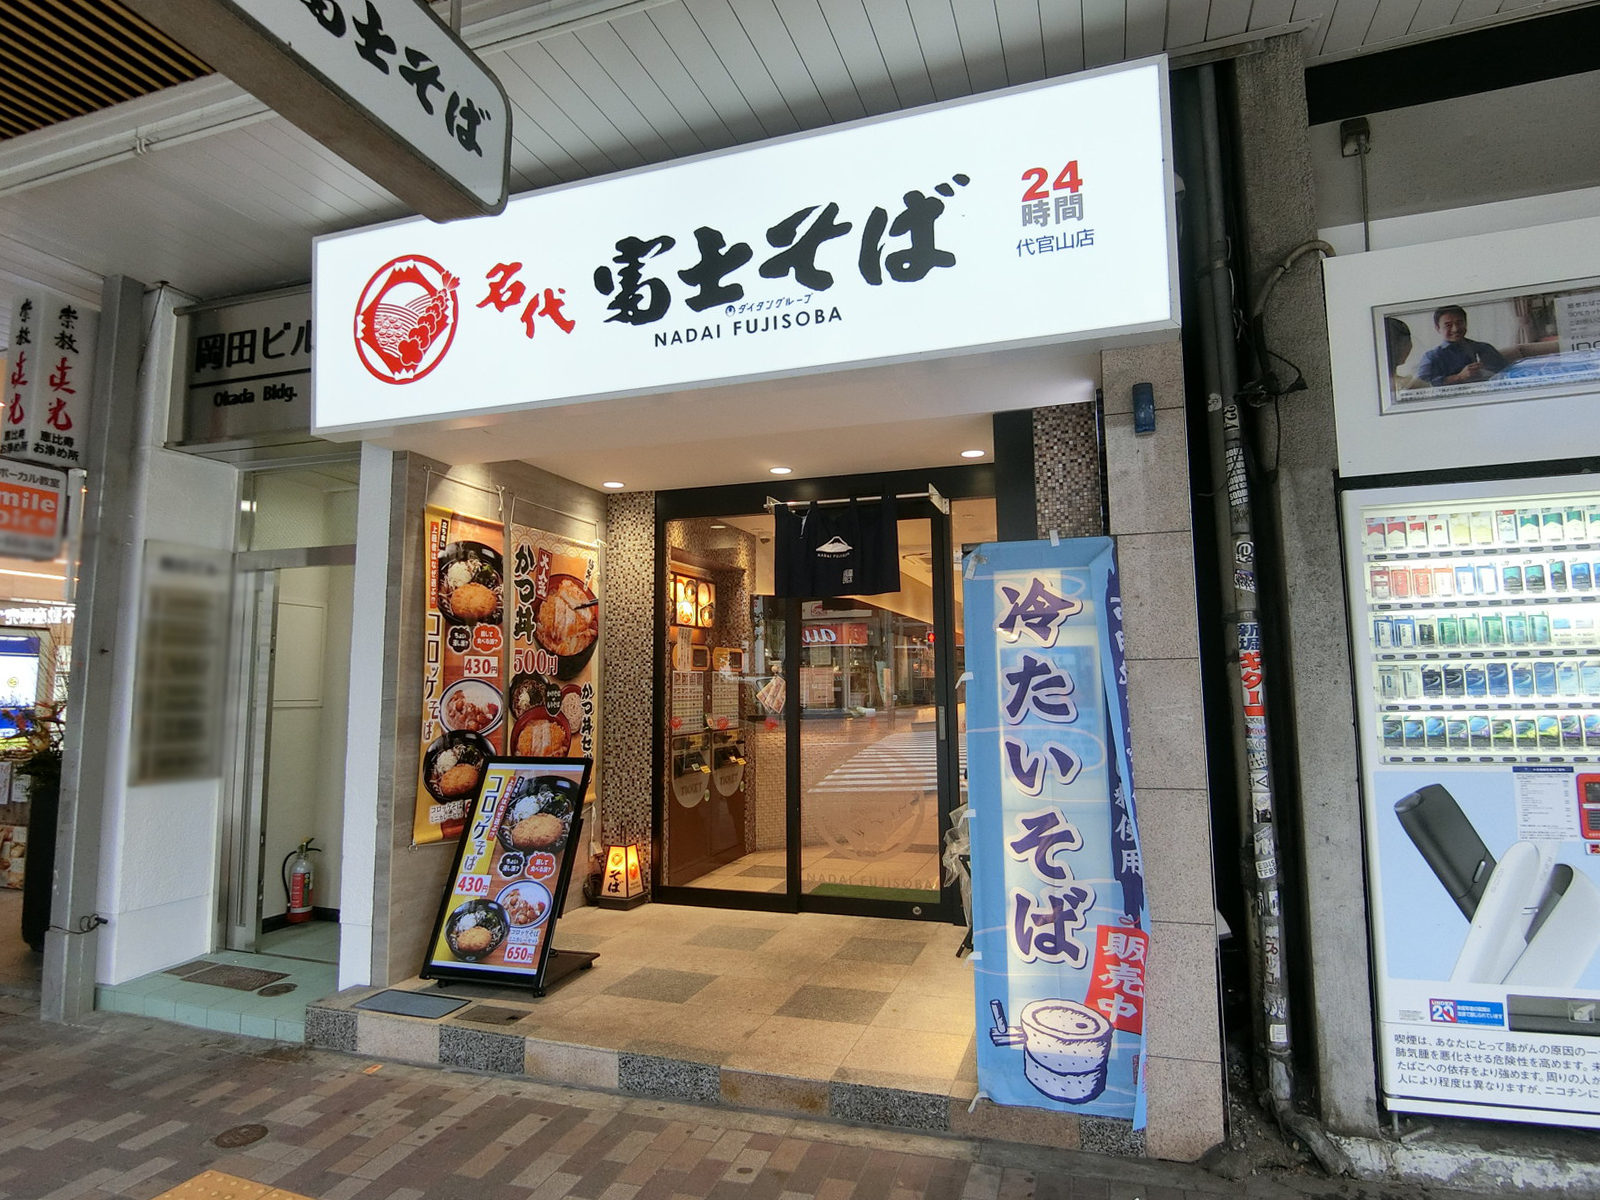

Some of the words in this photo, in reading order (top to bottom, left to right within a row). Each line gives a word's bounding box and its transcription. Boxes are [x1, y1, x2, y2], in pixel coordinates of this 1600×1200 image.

[1021, 159, 1083, 203] 24
[1022, 193, 1084, 227] 時間
[476, 261, 576, 339] 名代
[593, 172, 971, 326] 富士そば
[1016, 229, 1095, 257] 代官山店
[737, 292, 814, 315] ダイタングループ
[195, 319, 312, 373] 岡田ビル
[654, 323, 721, 348] NADAI
[733, 306, 842, 337] FUJISOBA
[213, 388, 255, 407] Okada
[263, 383, 298, 402] Bldg.
[513, 544, 536, 643] かつ丼
[424, 613, 441, 742] コロッケそば
[464, 658, 498, 674] 430円
[513, 649, 559, 676] 500円
[998, 576, 1088, 962] 冷たいそば
[464, 776, 502, 871] コロッケそば
[457, 876, 489, 894] 430円
[608, 869, 624, 893] そば
[507, 946, 533, 961] 650円
[1097, 931, 1146, 1023] 販売中
